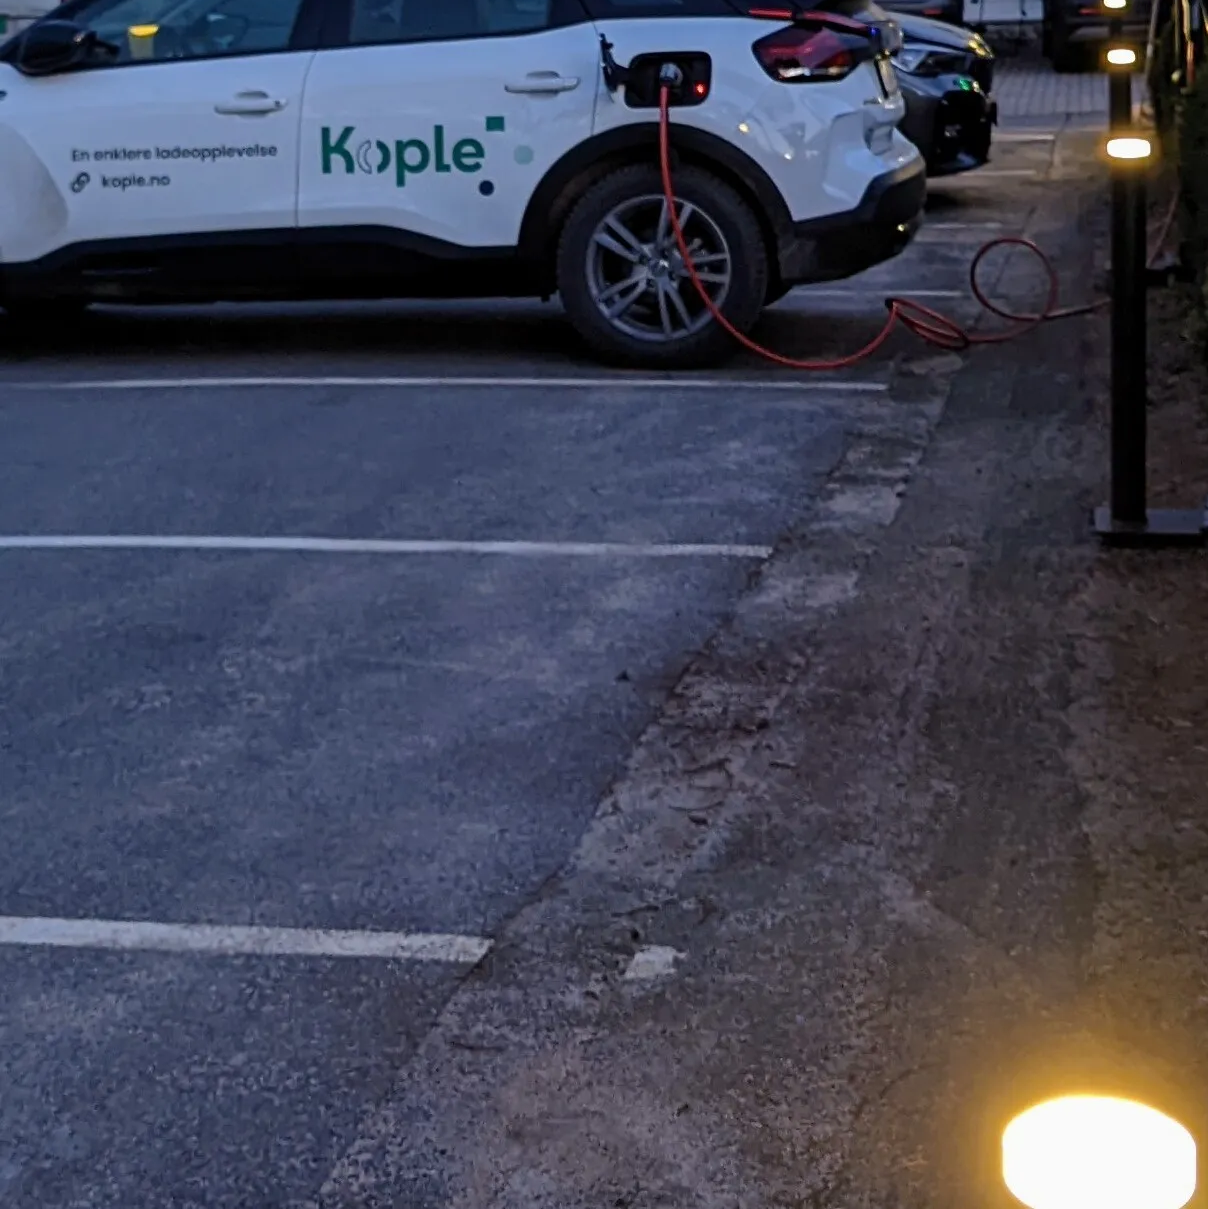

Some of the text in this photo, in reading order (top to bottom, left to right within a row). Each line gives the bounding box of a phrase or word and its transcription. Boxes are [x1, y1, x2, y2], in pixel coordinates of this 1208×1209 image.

[71, 144, 278, 162] En enklere ladeopplevelse
[320, 125, 485, 188] Kople
[101, 173, 171, 191] kople.no
